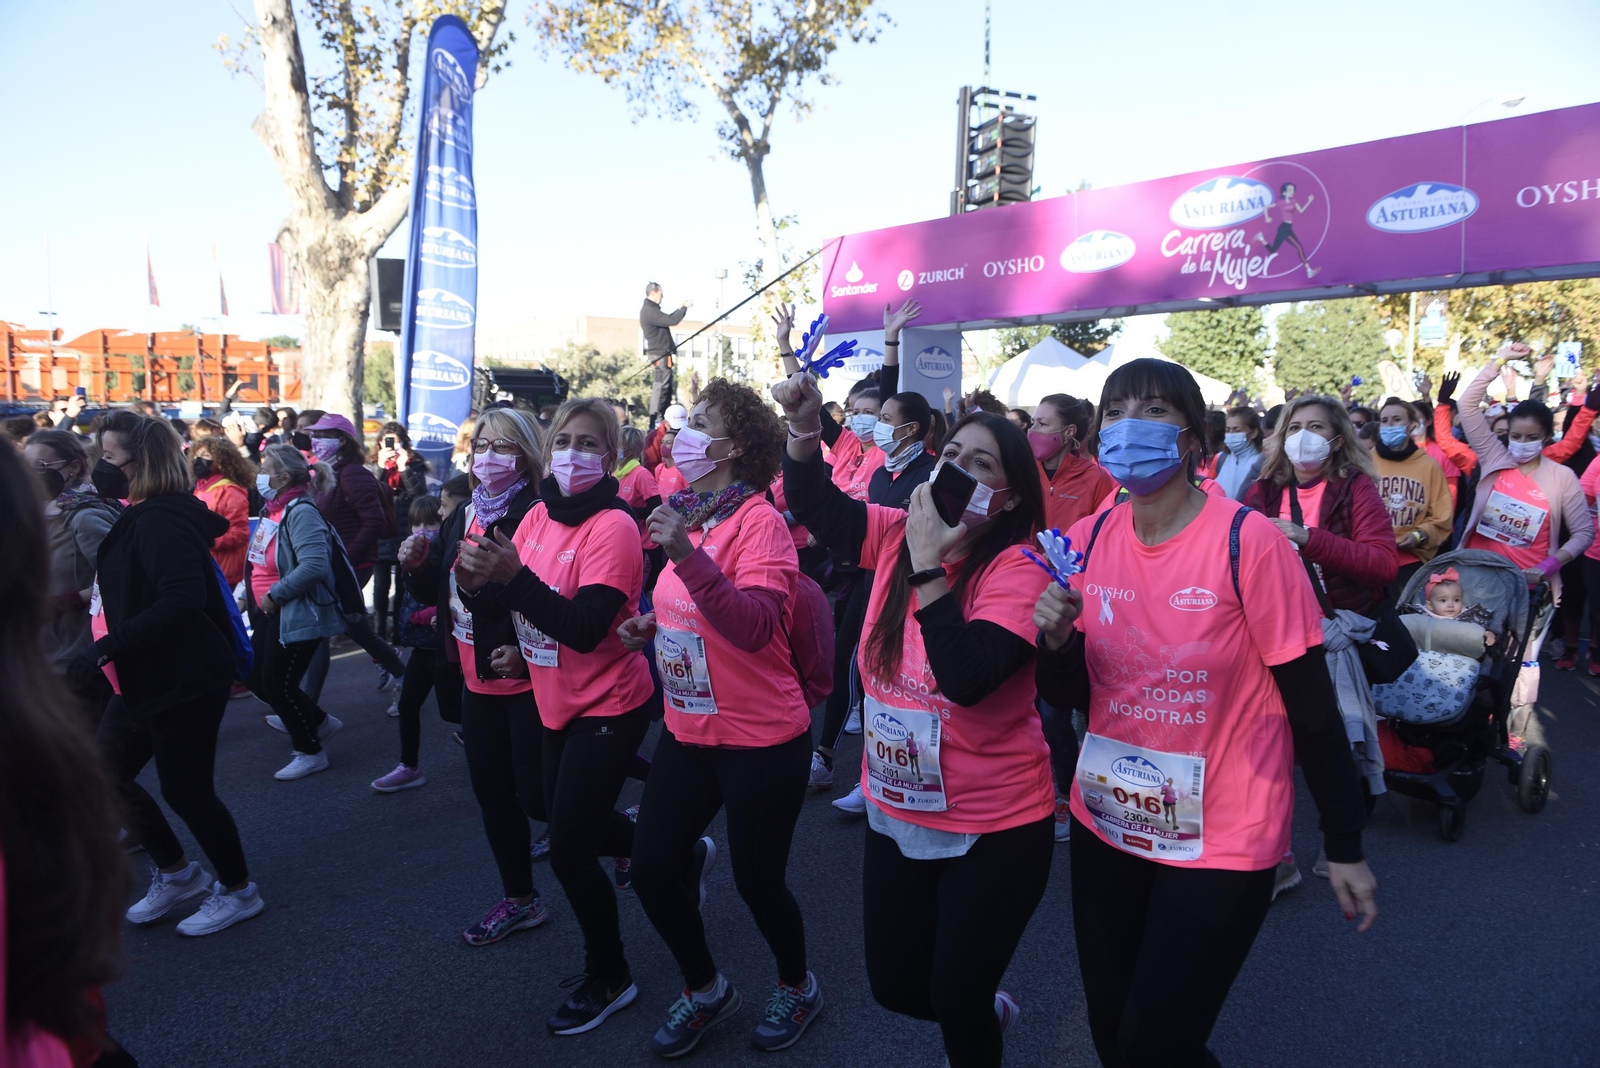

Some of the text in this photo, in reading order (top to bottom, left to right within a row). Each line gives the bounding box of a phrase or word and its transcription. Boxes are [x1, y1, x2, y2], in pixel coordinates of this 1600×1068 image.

[1375, 201, 1469, 224] ASTURIANA
[1161, 229, 1245, 257] Carrera
[983, 254, 1044, 278] OYSHO
[1181, 243, 1279, 291] de la Mujer
[918, 267, 965, 285] ZURICH
[831, 282, 878, 298] Santander
[918, 357, 953, 371] ASTURIANA
[1499, 514, 1523, 529] 016
[1230, 529, 1239, 556] SPORT
[1086, 583, 1136, 602] OYSHO
[1173, 595, 1214, 605] ASTURIANA
[675, 598, 697, 614] POR
[667, 609, 697, 629] TODAS
[663, 659, 685, 678] 016
[1166, 669, 1208, 683] POR
[1142, 687, 1207, 704] TODAS
[1109, 699, 1207, 725] NOSOTRAS
[875, 718, 906, 738] ASTURIANA
[876, 740, 909, 767] 016
[882, 765, 899, 779] 2101
[1115, 761, 1161, 785] ASTURIANA
[902, 782, 924, 791] MUJER
[1112, 786, 1162, 815] 016
[1101, 813, 1179, 840] CARRERA DE LA MUJER
[1124, 810, 1150, 824] 2304
[1169, 845, 1194, 853] ZURICH
